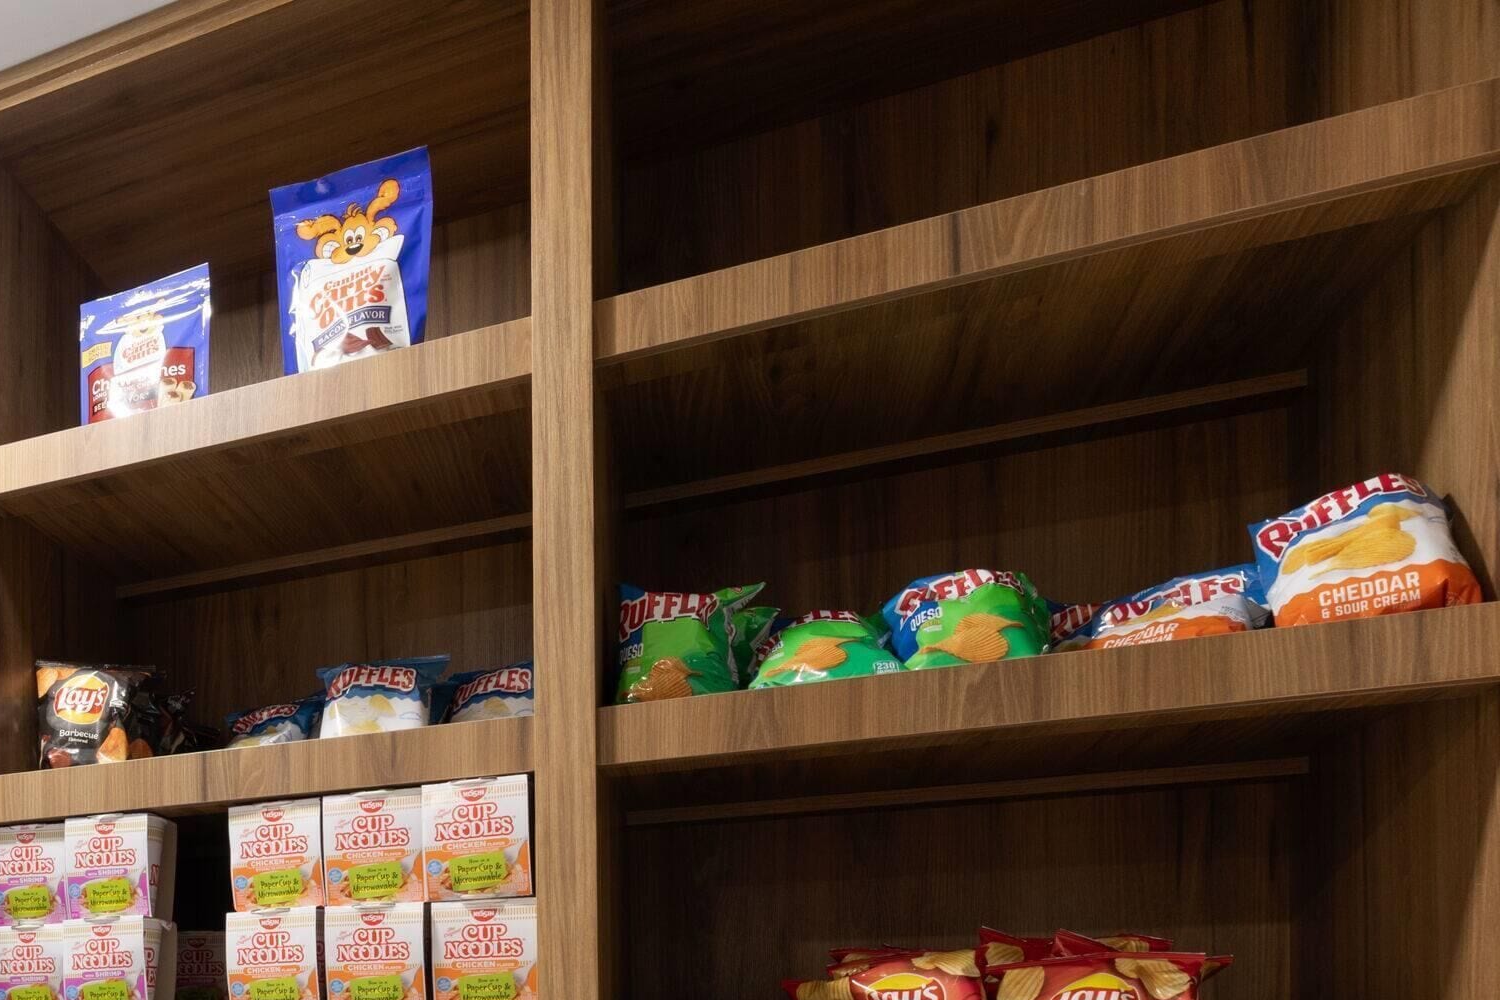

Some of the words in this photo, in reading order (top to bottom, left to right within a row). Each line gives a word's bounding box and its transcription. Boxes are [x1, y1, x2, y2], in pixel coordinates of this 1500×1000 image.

[348, 311, 385, 324] FLAVOR
[1256, 473, 1427, 561] RUFFLES
[1319, 571, 1420, 607] CHEDDAR
[1321, 608, 1329, 618] &
[1335, 601, 1369, 617] SOUR
[1373, 589, 1421, 609] CREAM
[910, 607, 942, 632] QUESO
[1104, 623, 1179, 649] CHEDDAR
[876, 662, 896, 670] 230
[327, 665, 417, 700] RUFFLES
[454, 668, 532, 709] RUFFLES
[57, 687, 106, 712] Lay's
[60, 729, 98, 739] Barbecue
[453, 802, 497, 822] CUP
[256, 823, 293, 841] CUP
[352, 814, 394, 833] CUP
[436, 816, 514, 841] NOODLES
[88, 837, 123, 852] CUP
[241, 835, 308, 859] NOODLES
[336, 828, 409, 850] NOODLES
[447, 841, 486, 849] CHICKEN
[10, 846, 42, 861] CUP
[75, 851, 136, 868] NOODLES
[346, 851, 383, 859] CHICKEN
[0, 858, 54, 876] NOODLES
[251, 859, 284, 867] CHICKEN
[252, 932, 290, 948] CUP
[353, 928, 394, 946] CUP
[462, 924, 507, 941] CUP
[12, 945, 43, 960] CUP
[86, 938, 119, 953] CUP
[337, 942, 409, 962] NOODLES
[444, 938, 523, 959] NOODLES
[72, 951, 133, 969] NOODLES
[237, 945, 304, 965] NOODLES
[1, 958, 55, 974] NOODLES
[247, 966, 280, 974] CHICKEN
